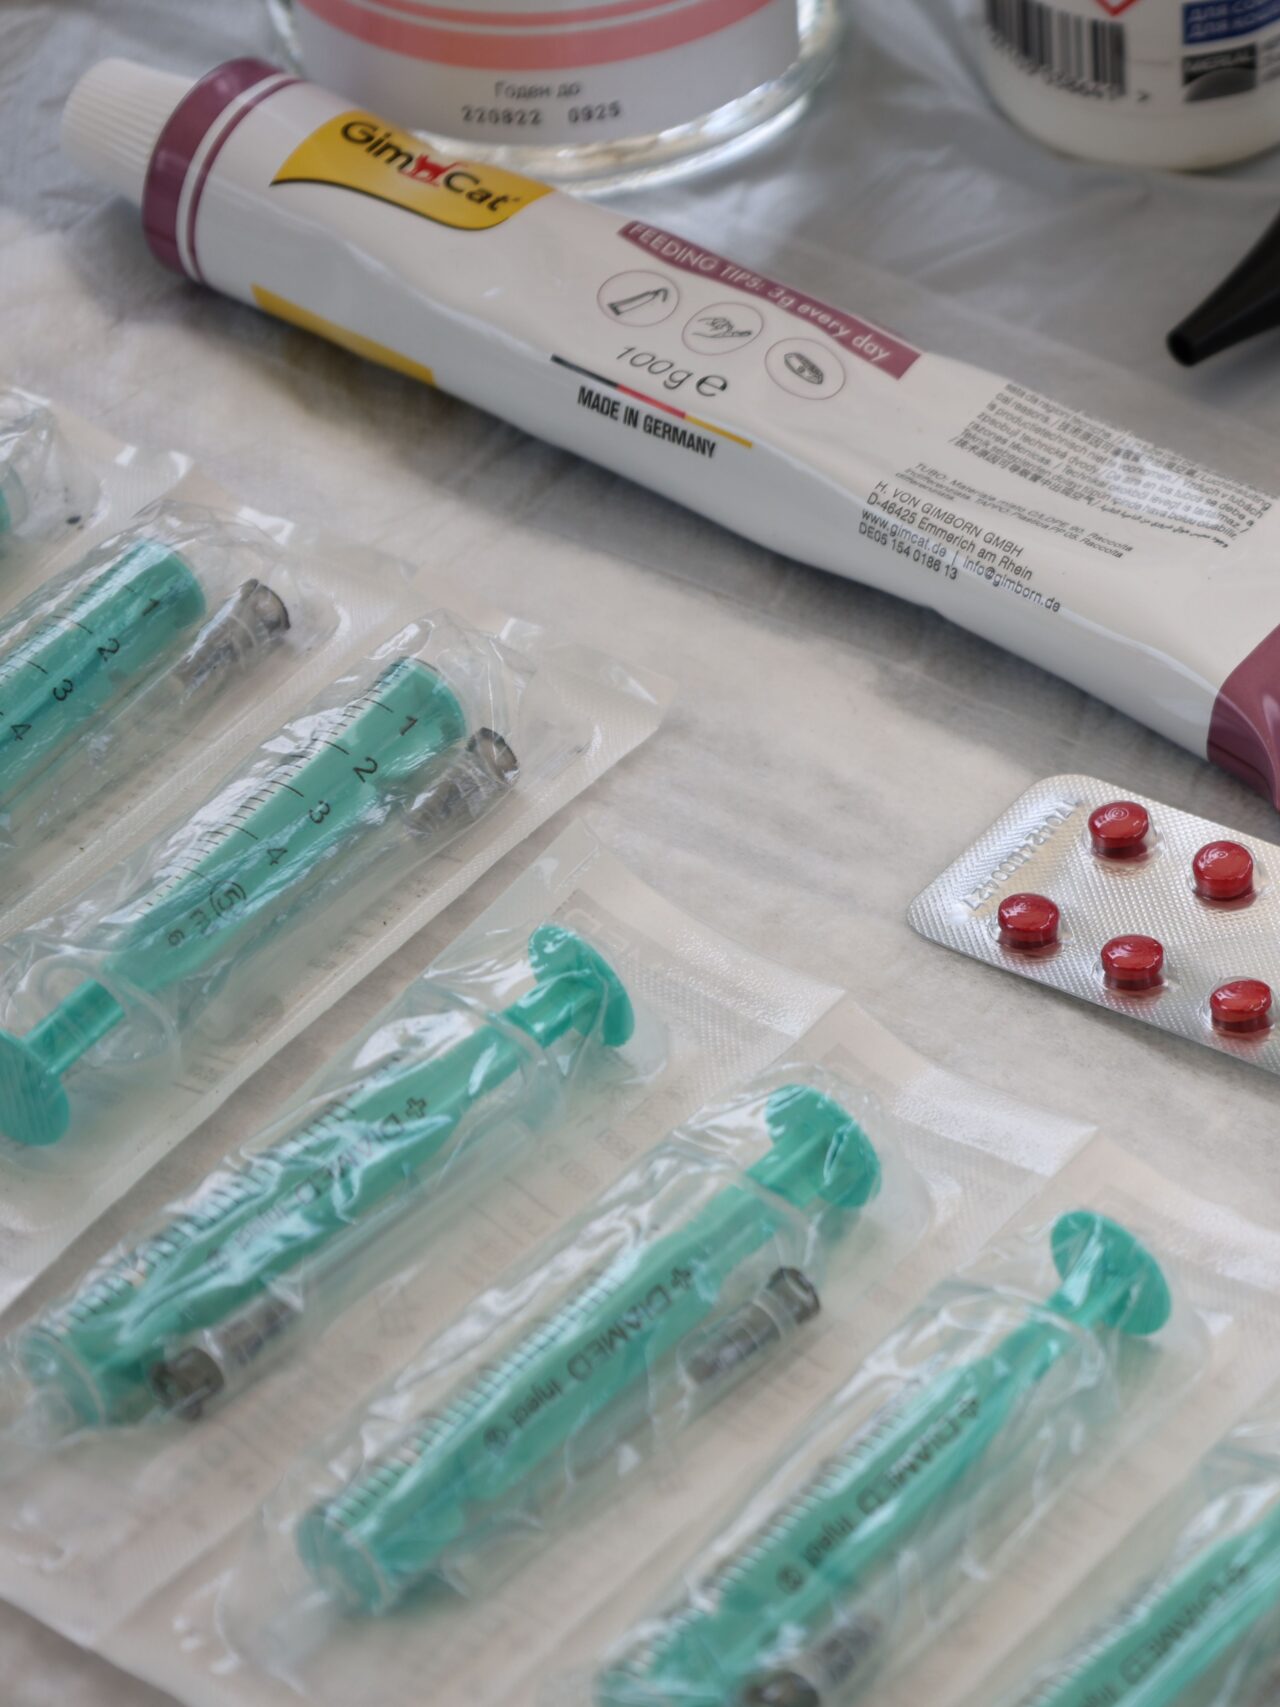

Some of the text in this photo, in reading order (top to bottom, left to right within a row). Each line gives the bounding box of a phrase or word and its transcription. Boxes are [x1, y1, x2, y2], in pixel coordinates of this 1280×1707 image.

[494, 81, 583, 99] Годен до
[628, 222, 890, 362] FEEDING TIPS: 3g every day
[616, 346, 694, 390] 100g
[577, 385, 717, 458] MADE IN GERMANY
[874, 480, 1025, 558] H. VON GIMBORN GMBH
[866, 492, 1034, 581] D-46425 Emmerich am Rhein
[858, 522, 958, 580] DE05 154 0186 13
[861, 510, 1061, 612] www.gimcat.de info@gimborn.de
[96, 637, 120, 662] 2
[52, 678, 73, 701] 3
[10, 723, 32, 741] 4
[399, 715, 419, 736] 1
[352, 756, 379, 784] 2
[308, 800, 331, 824] 3
[266, 846, 289, 867] 4
